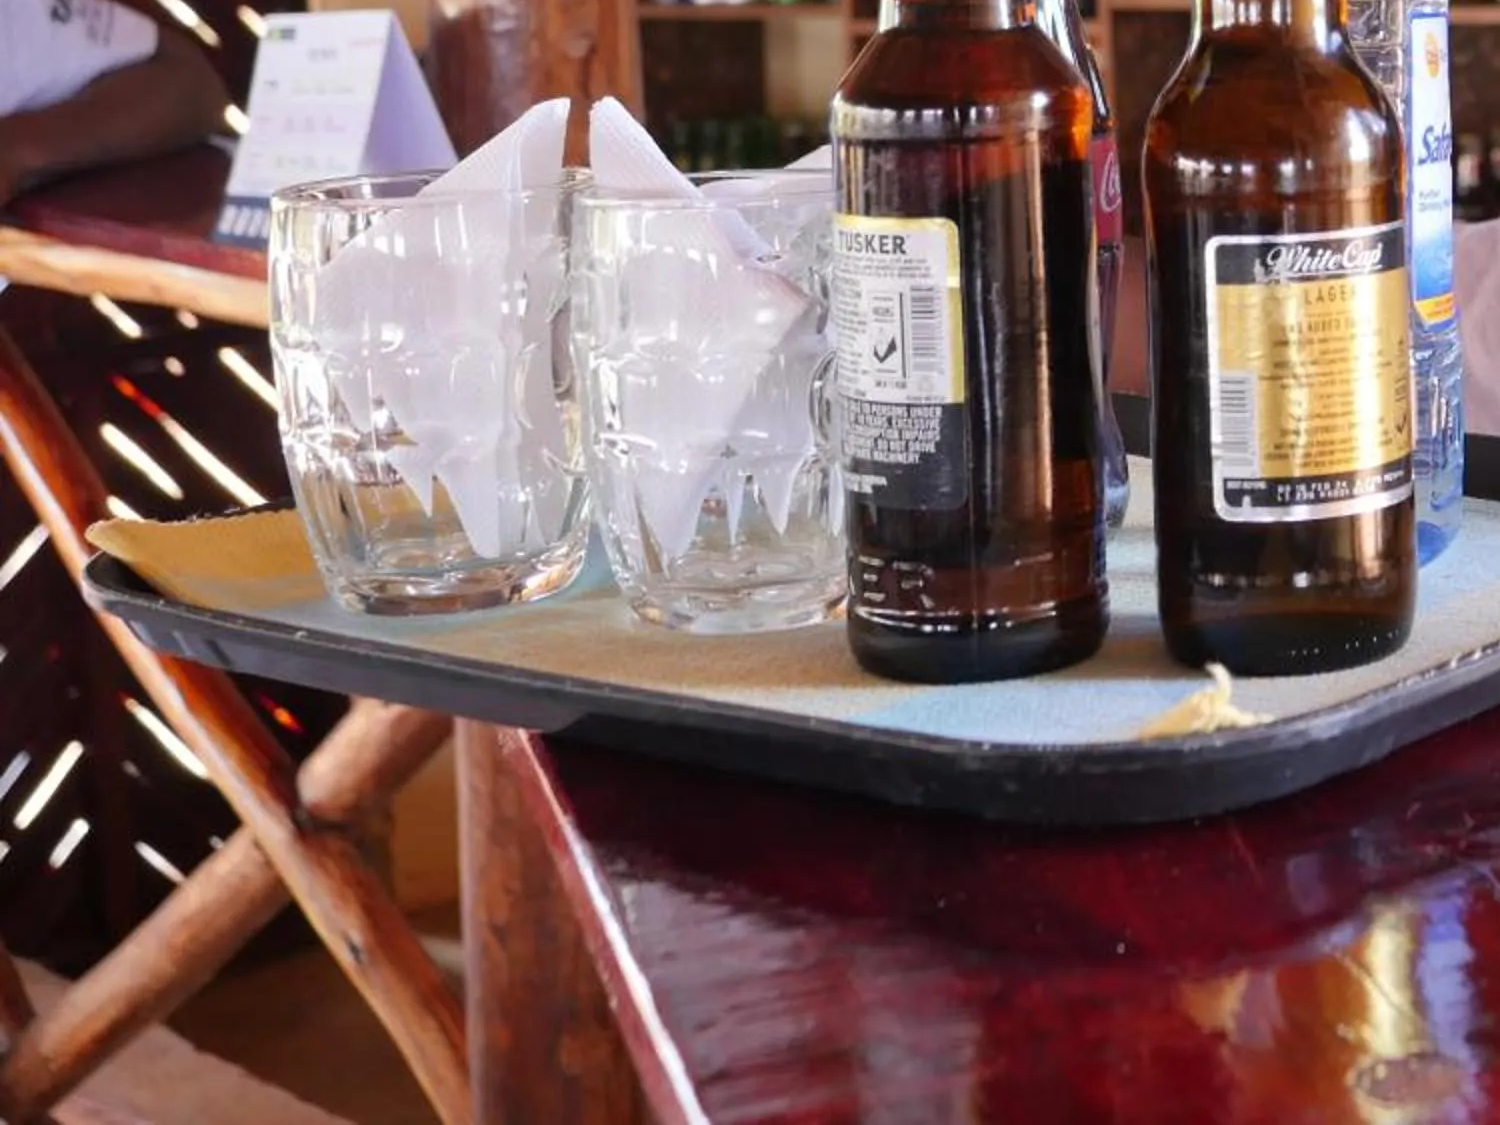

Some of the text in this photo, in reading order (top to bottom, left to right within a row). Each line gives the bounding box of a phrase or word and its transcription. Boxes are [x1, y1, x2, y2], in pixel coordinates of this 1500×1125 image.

[838, 230, 907, 255] TUSKER
[1267, 238, 1384, 277] White Cap
[1304, 281, 1357, 306] LAGE
